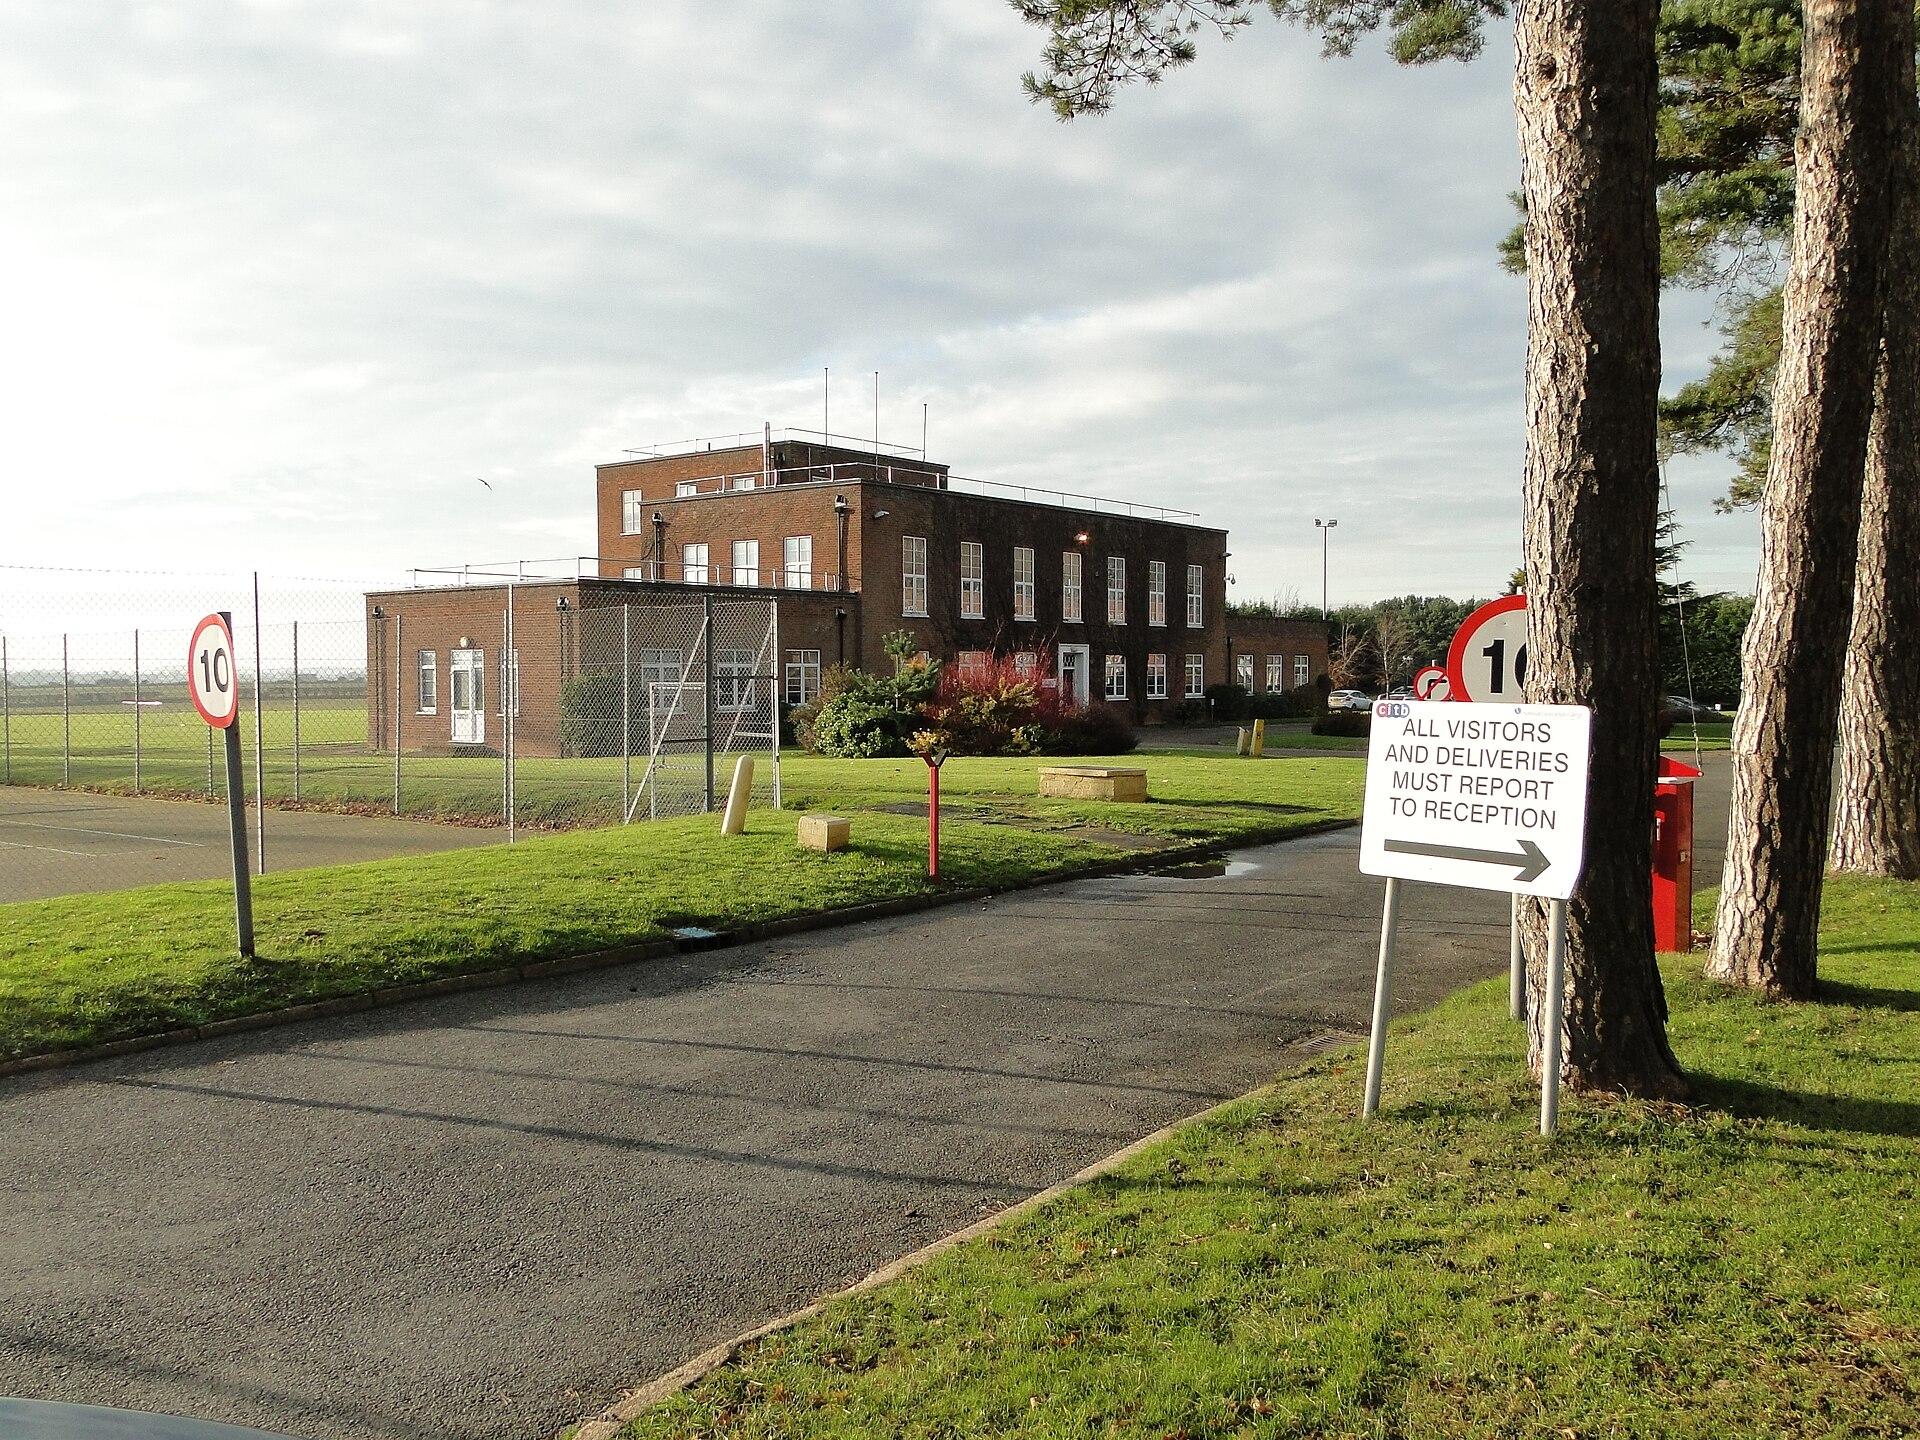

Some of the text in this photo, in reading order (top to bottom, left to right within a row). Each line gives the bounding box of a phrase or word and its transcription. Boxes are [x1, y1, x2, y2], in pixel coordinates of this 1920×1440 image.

[200, 648, 229, 693] 10
[1377, 703, 1410, 717] citb
[1402, 718, 1552, 743] ALL VISITORS
[1384, 744, 1569, 773] AND DELIVERIES
[1392, 770, 1554, 801] MUST REPORT
[1389, 797, 1556, 830] TO RECEPTION
